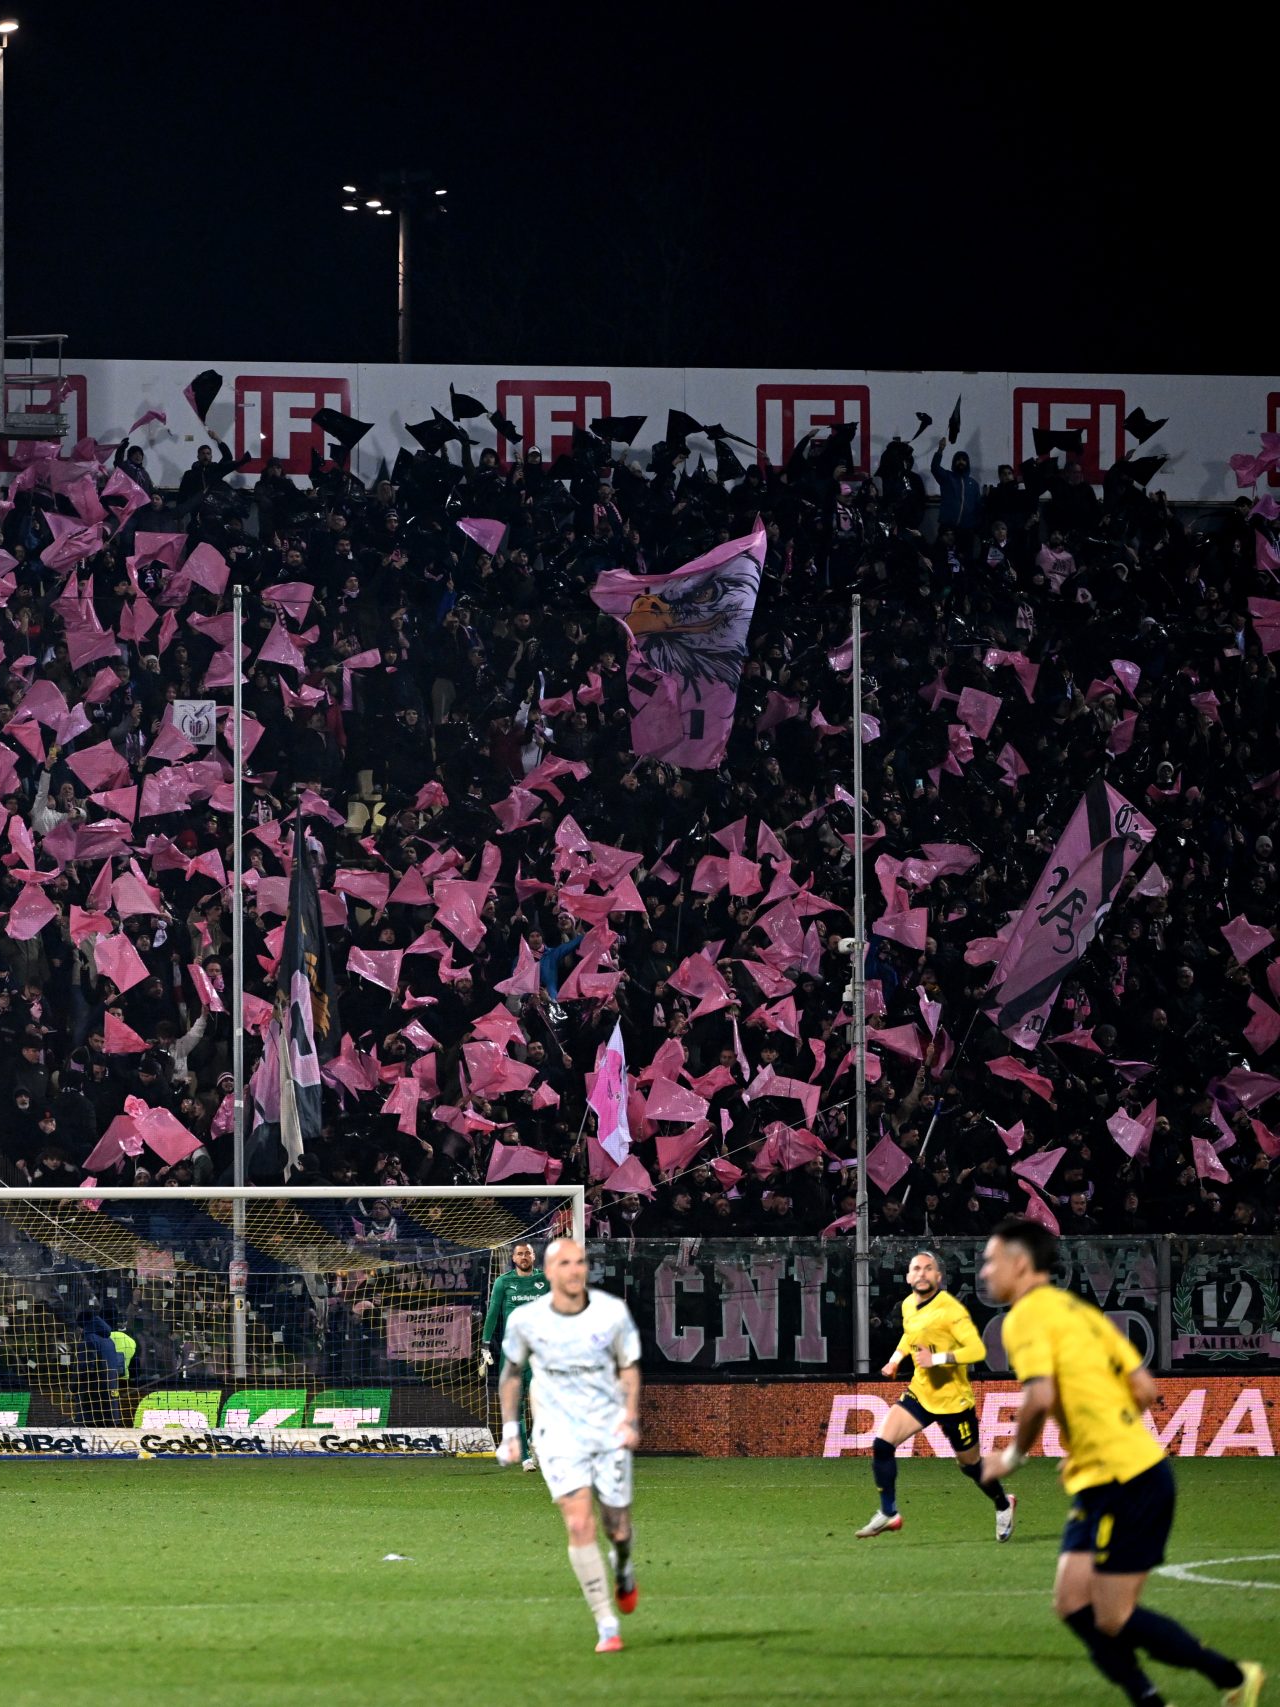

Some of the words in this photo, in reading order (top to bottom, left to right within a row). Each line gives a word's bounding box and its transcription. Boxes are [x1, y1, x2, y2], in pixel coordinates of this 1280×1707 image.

[1196, 1280, 1253, 1329] 12
[1189, 1336, 1265, 1350] PALERMO
[957, 1421, 972, 1440] 11
[139, 1433, 267, 1455] GoldBet
[319, 1432, 446, 1455] GoldBet
